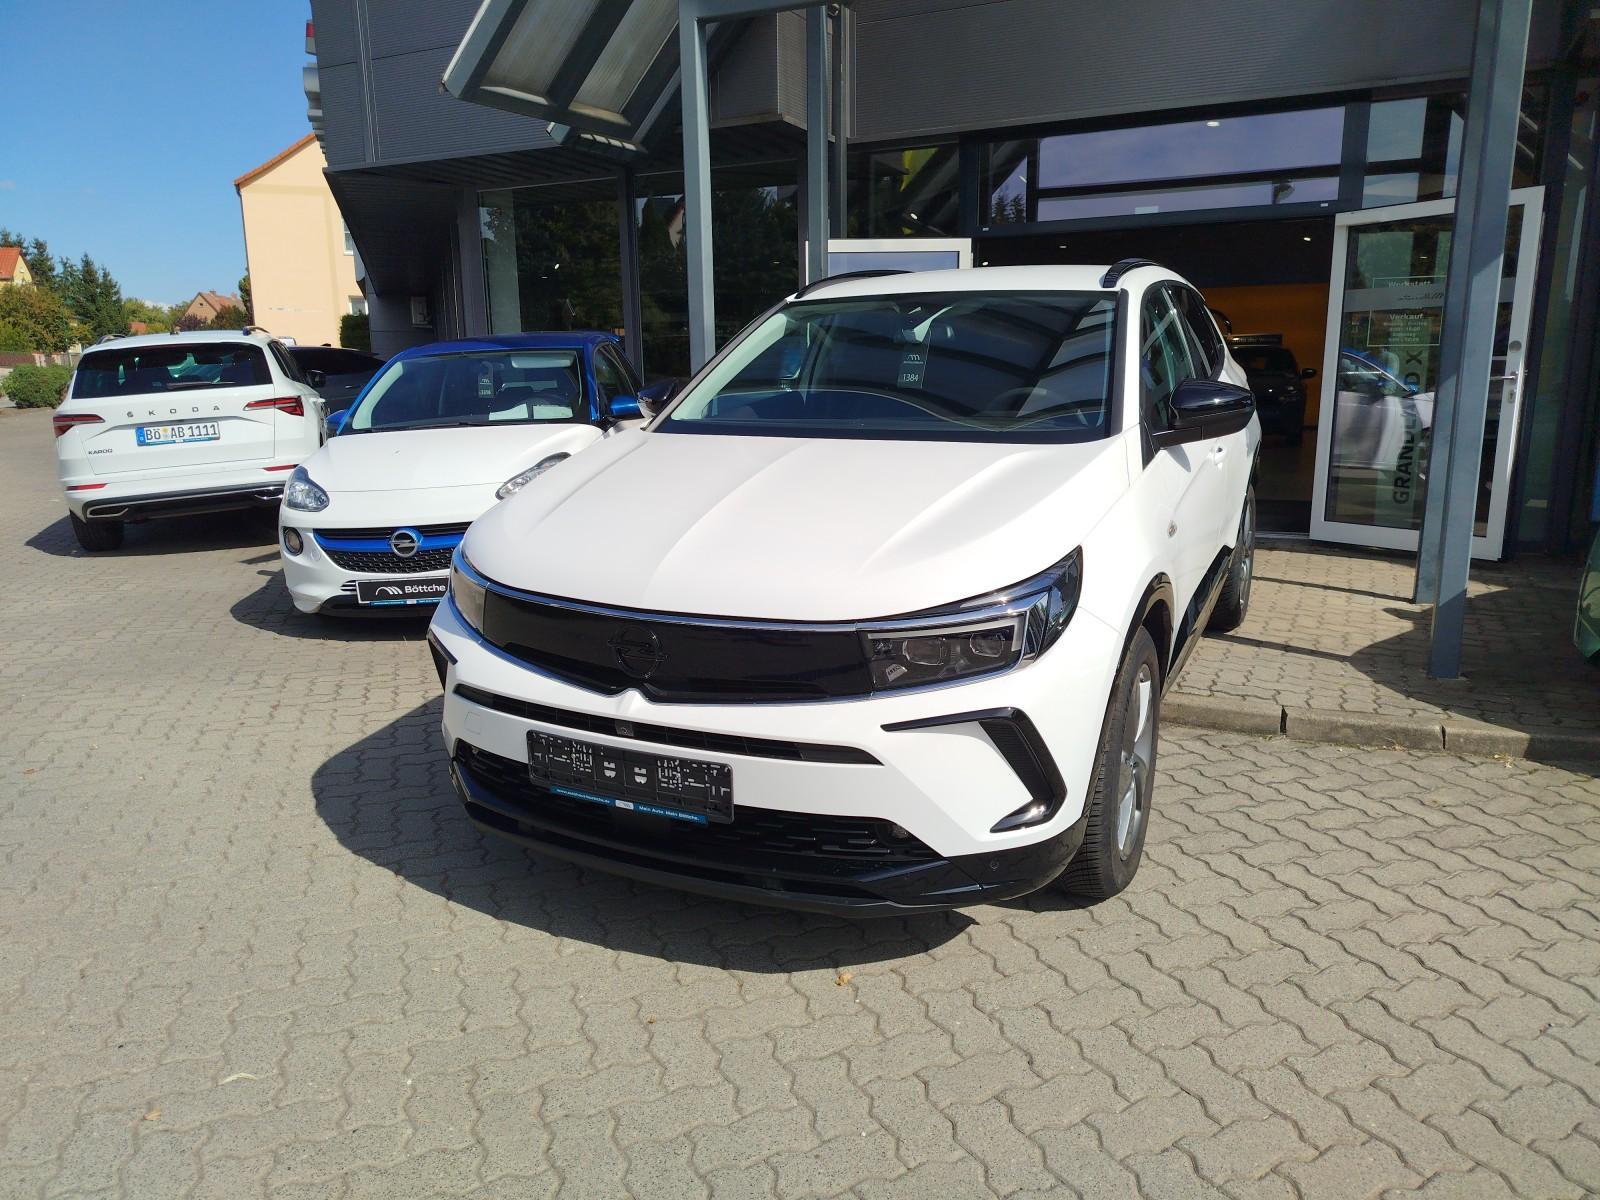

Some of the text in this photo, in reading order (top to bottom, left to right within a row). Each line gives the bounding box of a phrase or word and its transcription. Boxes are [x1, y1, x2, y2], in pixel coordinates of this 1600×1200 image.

[903, 373, 919, 382] 1384
[170, 426, 186, 439] AB
[187, 424, 217, 437] 1111
